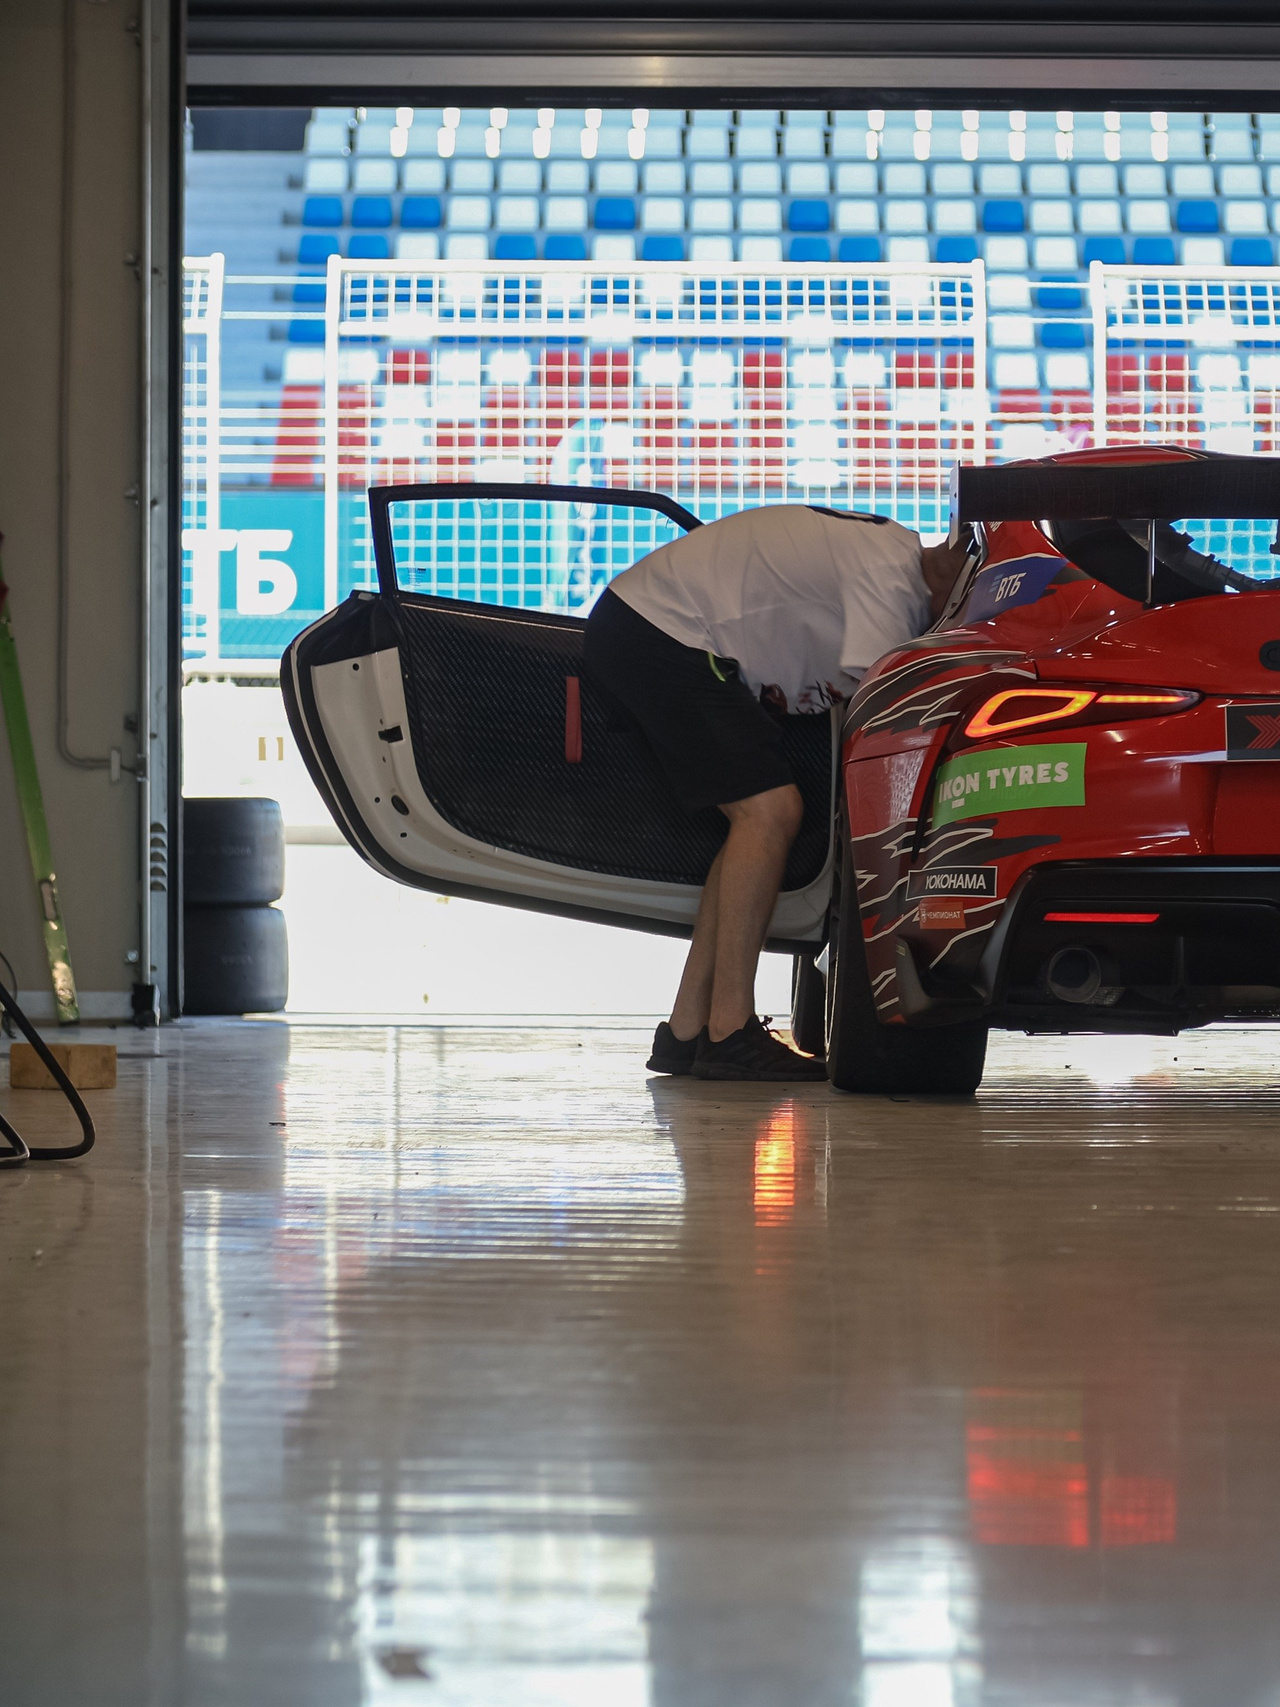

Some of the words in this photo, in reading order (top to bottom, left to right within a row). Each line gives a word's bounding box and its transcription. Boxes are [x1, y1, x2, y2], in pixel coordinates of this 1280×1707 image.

[995, 572, 1027, 603] ВТБ
[938, 771, 981, 804] IKON
[986, 761, 1069, 790] TYRES
[925, 873, 987, 890] YOKOHAMA
